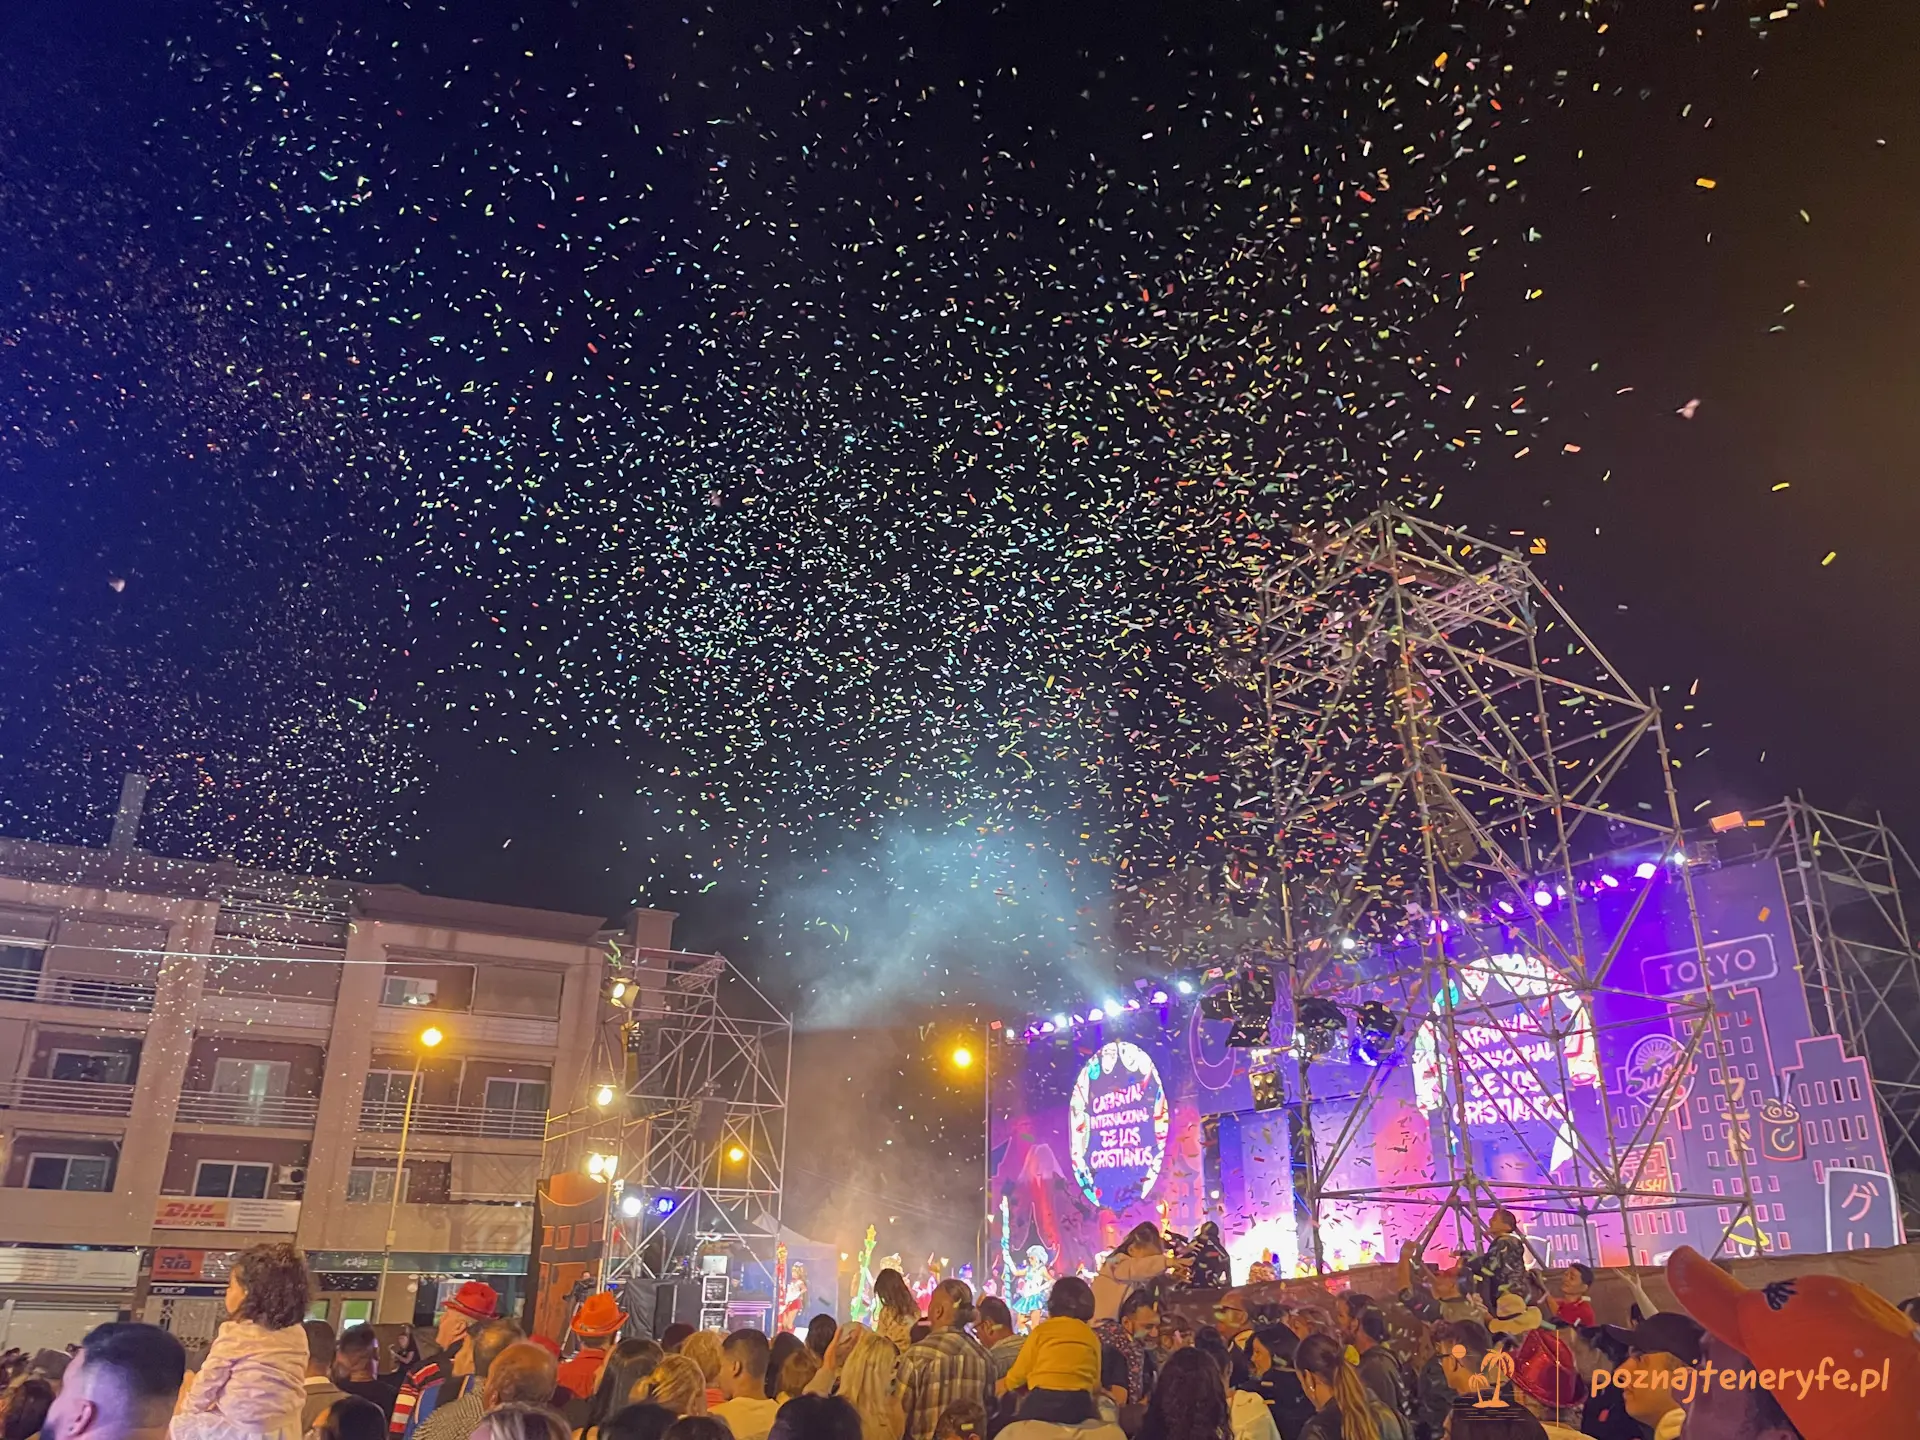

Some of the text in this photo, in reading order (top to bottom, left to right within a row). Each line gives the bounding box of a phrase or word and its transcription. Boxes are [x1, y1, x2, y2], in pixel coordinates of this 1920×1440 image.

[1099, 1126, 1141, 1148] DE LOS
[165, 1202, 215, 1218] DHL
[159, 1252, 192, 1269] Ria
